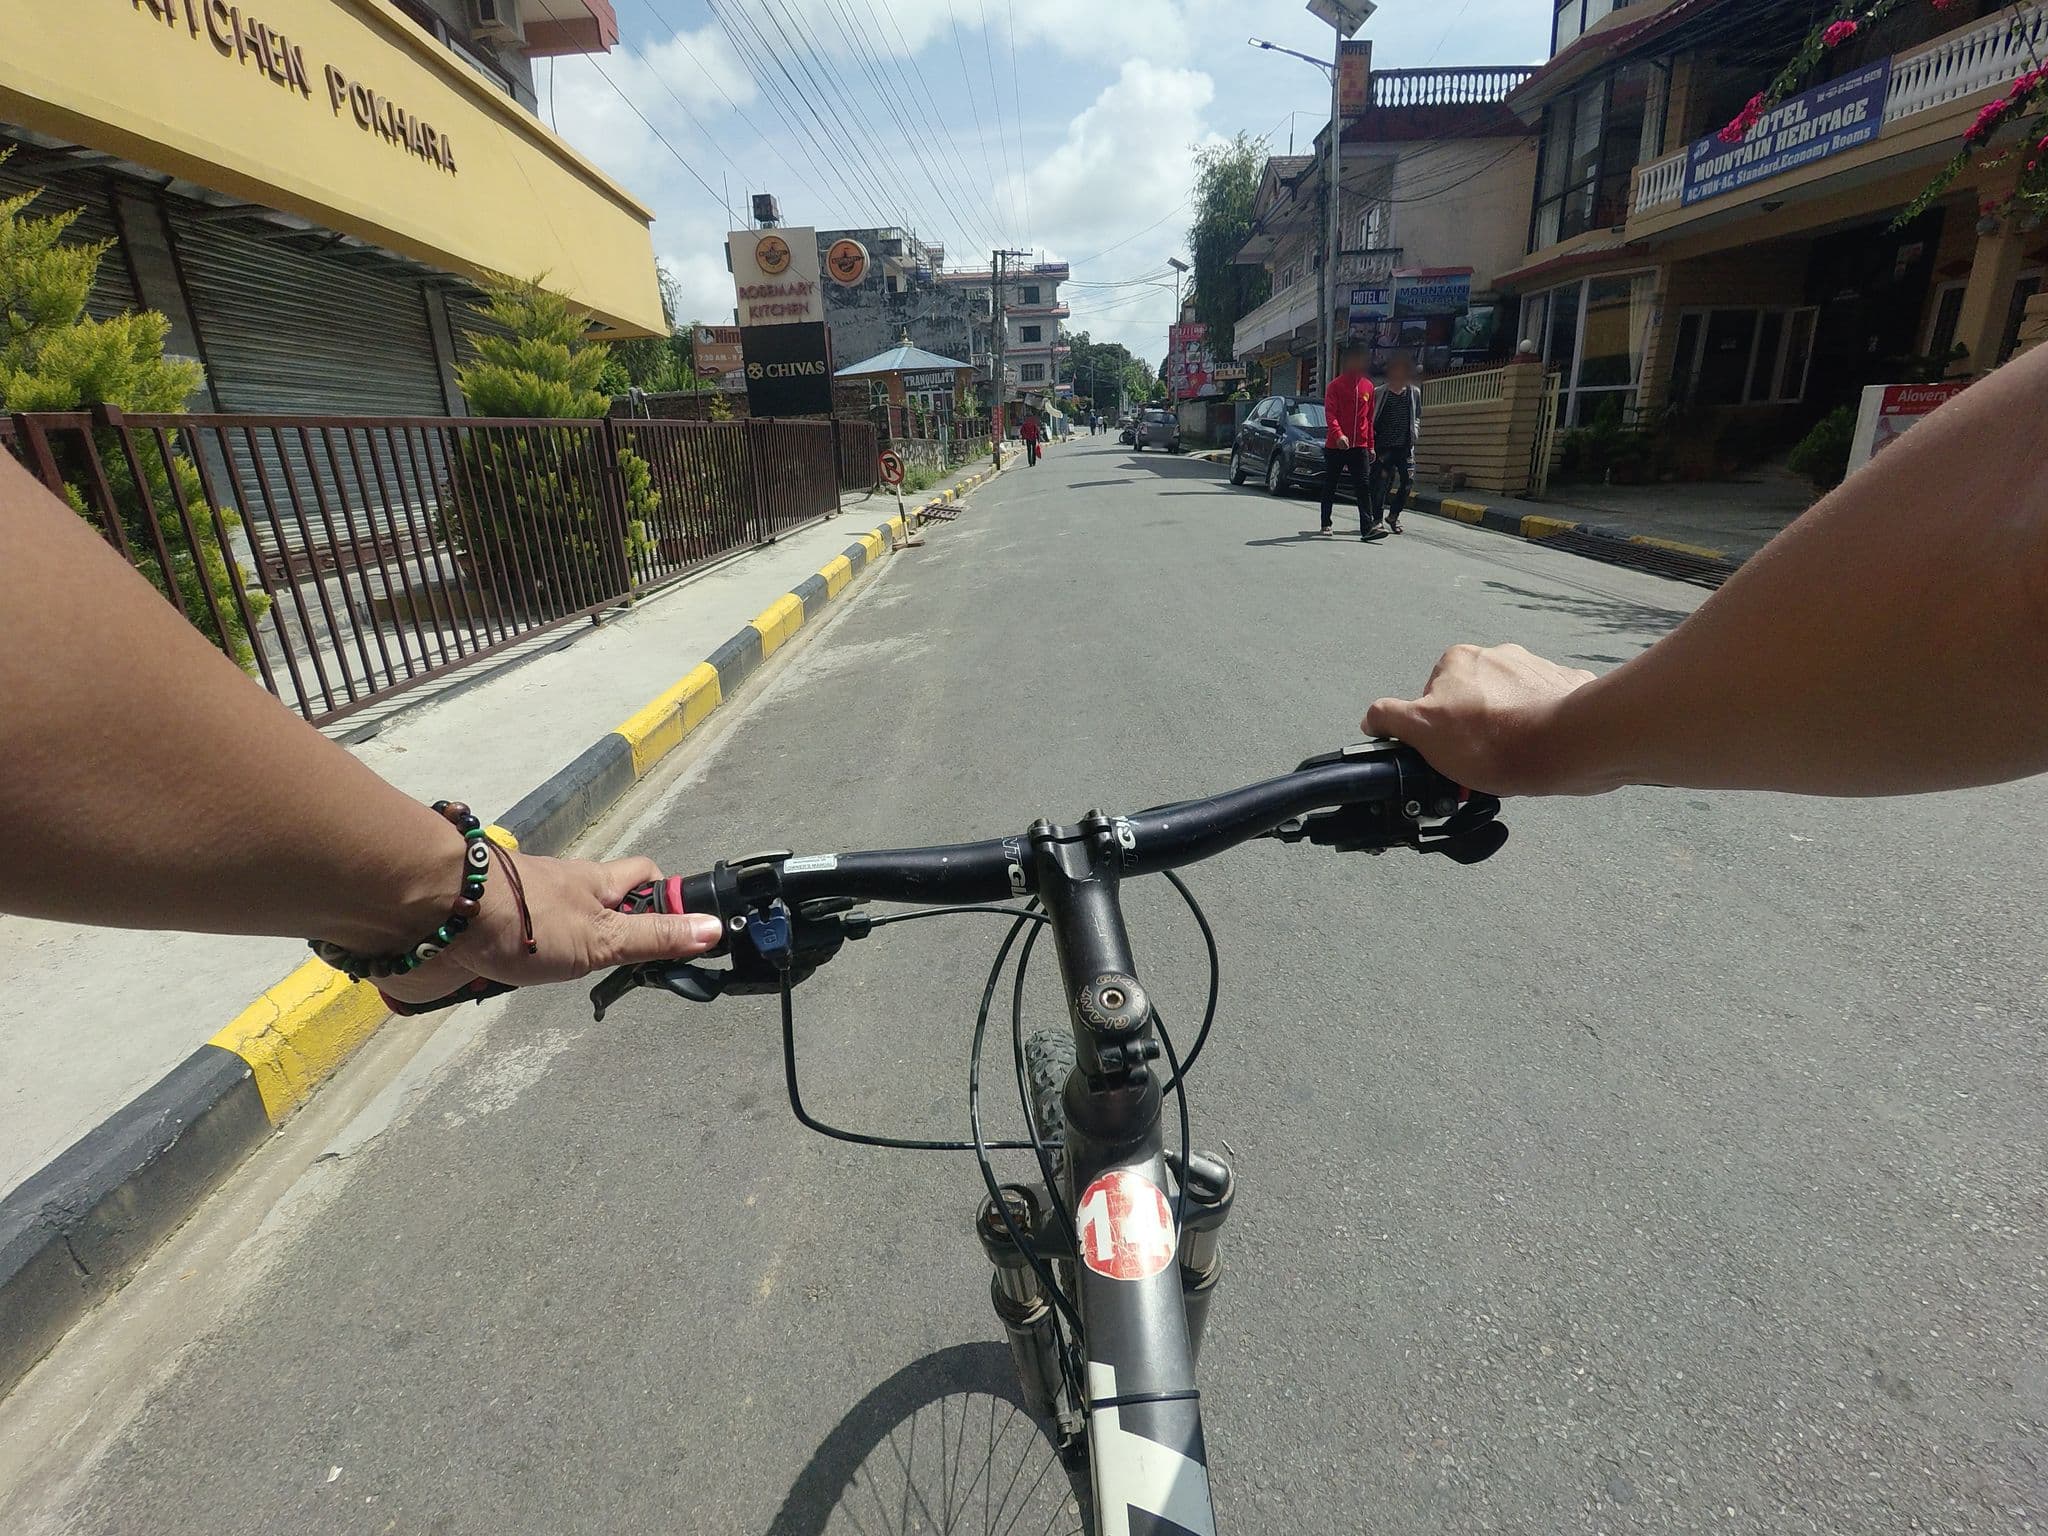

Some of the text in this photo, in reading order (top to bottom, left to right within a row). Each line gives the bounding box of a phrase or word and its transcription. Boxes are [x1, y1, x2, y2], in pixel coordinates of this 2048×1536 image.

[131, 0, 457, 178] ITCHEN POKHARA
[1694, 98, 1869, 184] MOUNTAIN HERITAGE
[1831, 127, 1872, 150] Rooms
[739, 281, 816, 299] ROSEMARY
[1353, 291, 1378, 304] HOTEL
[1400, 285, 1467, 297] MOUNTAIN
[748, 302, 810, 319] KITCHEN
[766, 360, 826, 378] CHIVAS
[1215, 361, 1245, 370] HOTEL
[904, 371, 954, 387] TRANQUILITY
[1898, 389, 1947, 402] Alovera
